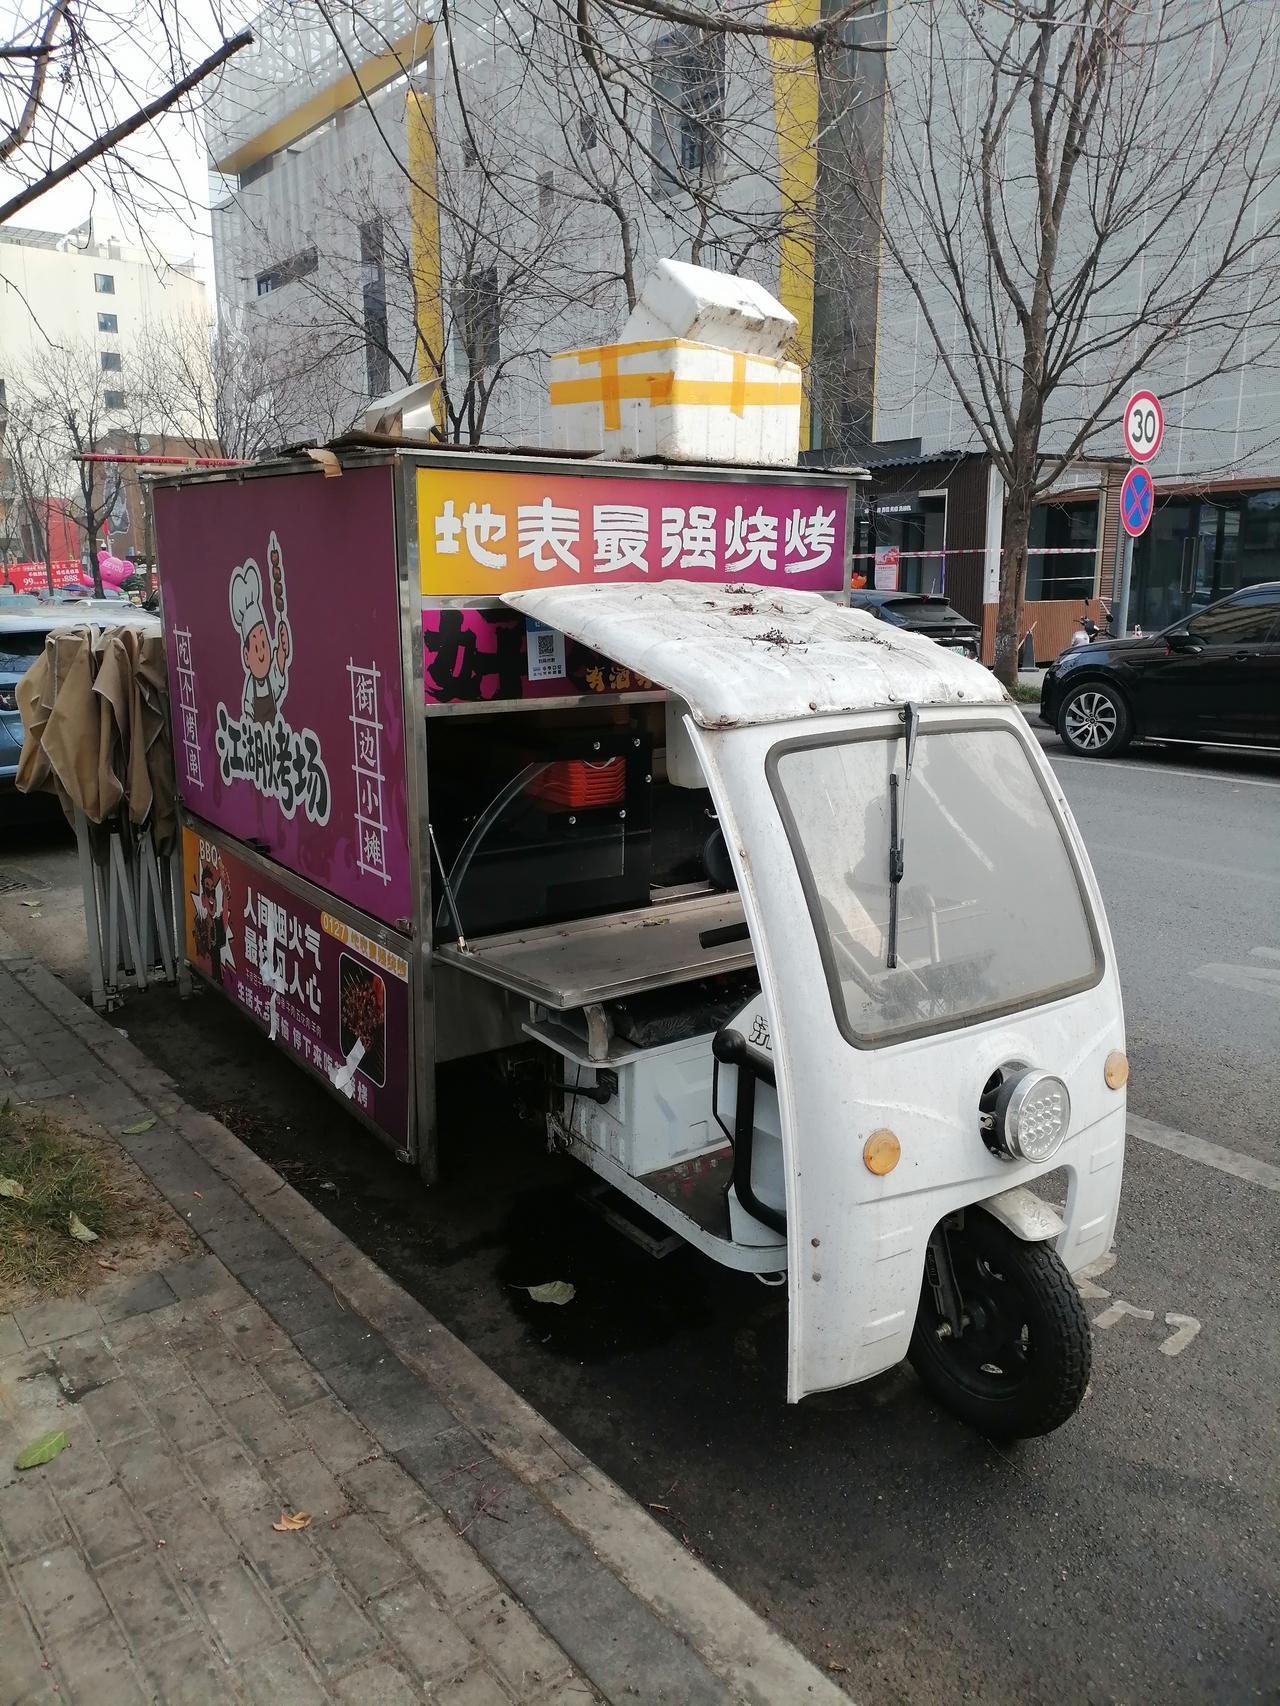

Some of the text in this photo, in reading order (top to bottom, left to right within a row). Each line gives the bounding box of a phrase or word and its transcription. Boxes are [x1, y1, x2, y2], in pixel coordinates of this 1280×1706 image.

[1131, 409, 1156, 444] 30
[434, 497, 837, 575] 地表最强烧烤
[178, 636, 199, 777] 吃个烤串
[356, 674, 383, 866] 街边小摊
[200, 839, 219, 870] BBQ
[243, 886, 322, 972] 人间烟火气
[323, 912, 347, 941] 0127
